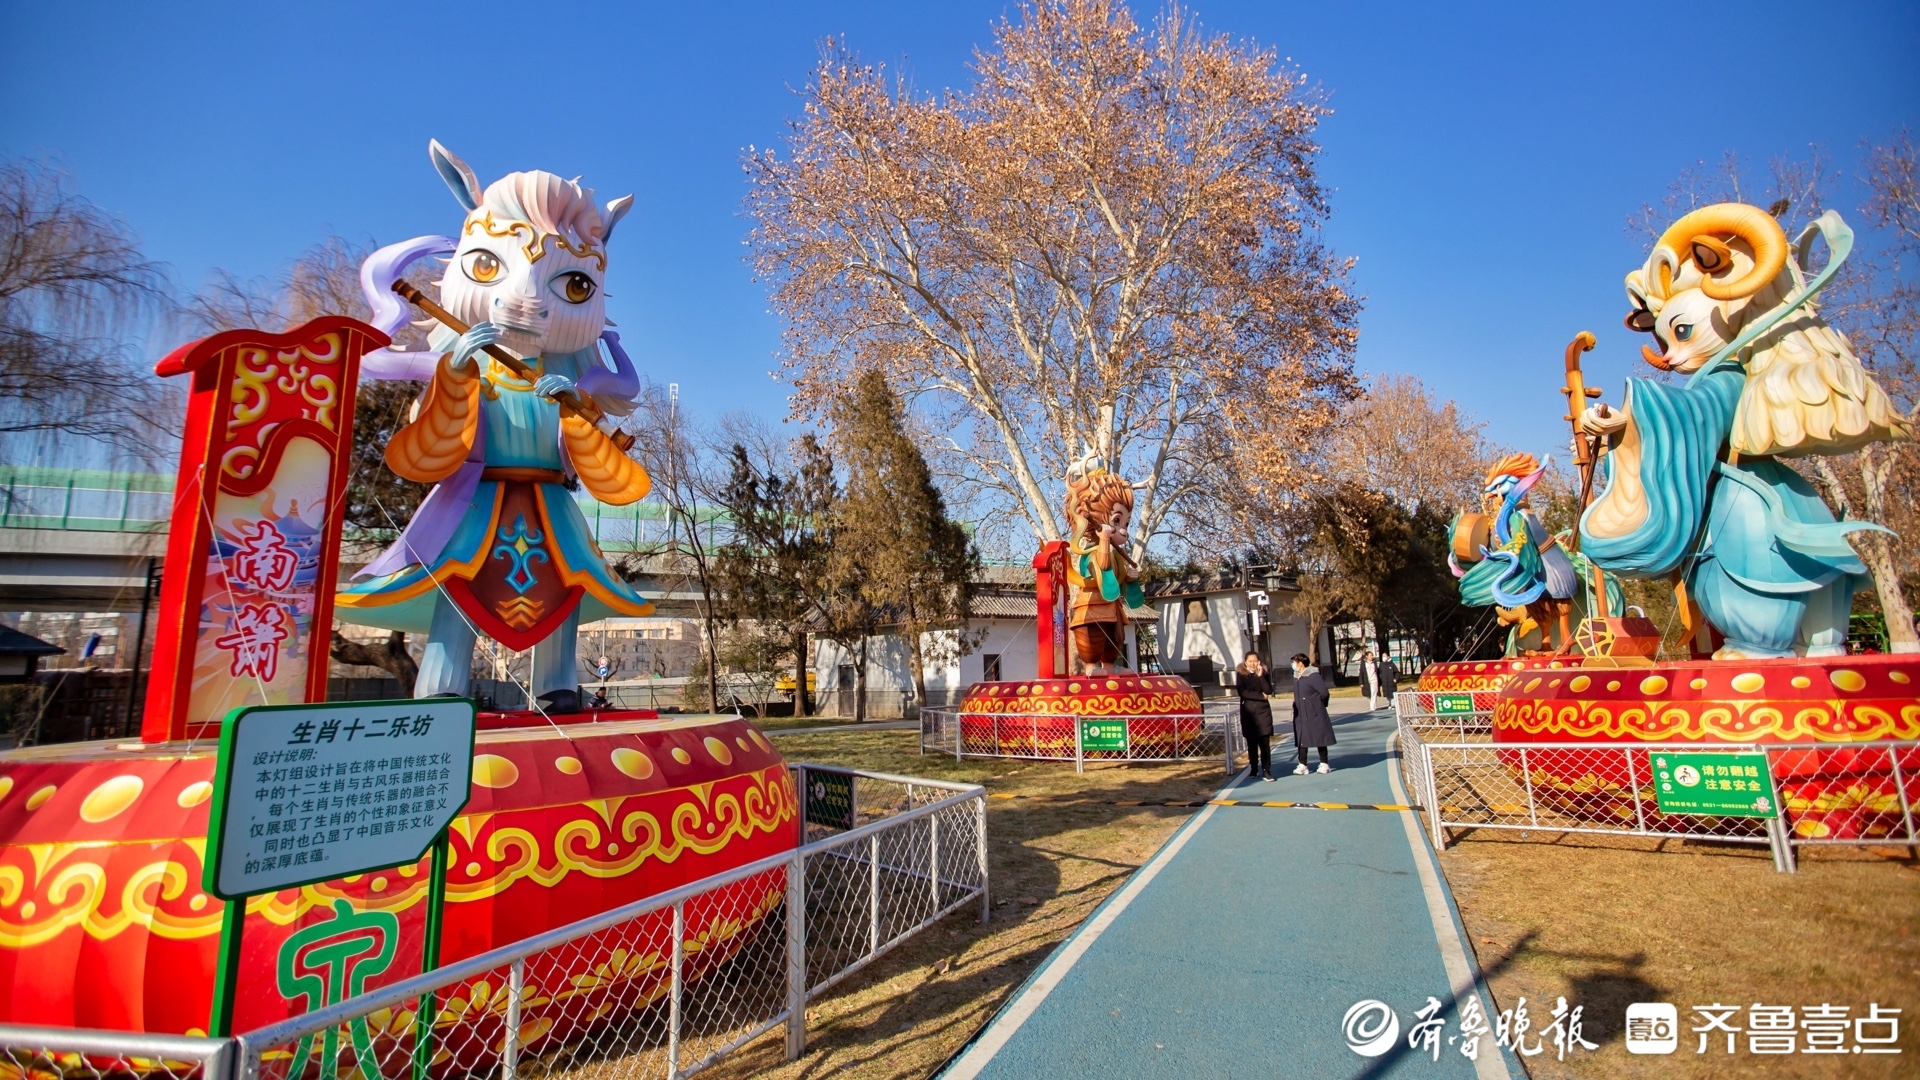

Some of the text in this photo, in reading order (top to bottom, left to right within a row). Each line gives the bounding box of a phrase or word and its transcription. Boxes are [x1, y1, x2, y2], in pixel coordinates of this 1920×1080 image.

[287, 714, 434, 745] 生肖十二乐坊
[256, 752, 451, 784] 本灯组设计旨在将中国传统文化
[1701, 765, 1759, 777] 请勿翻越
[255, 767, 450, 802] 中的十二生肖与古风乐器相结合
[1705, 779, 1761, 792] 注意安全
[249, 798, 447, 838] 仅展现了生肖的个性和象征意义
